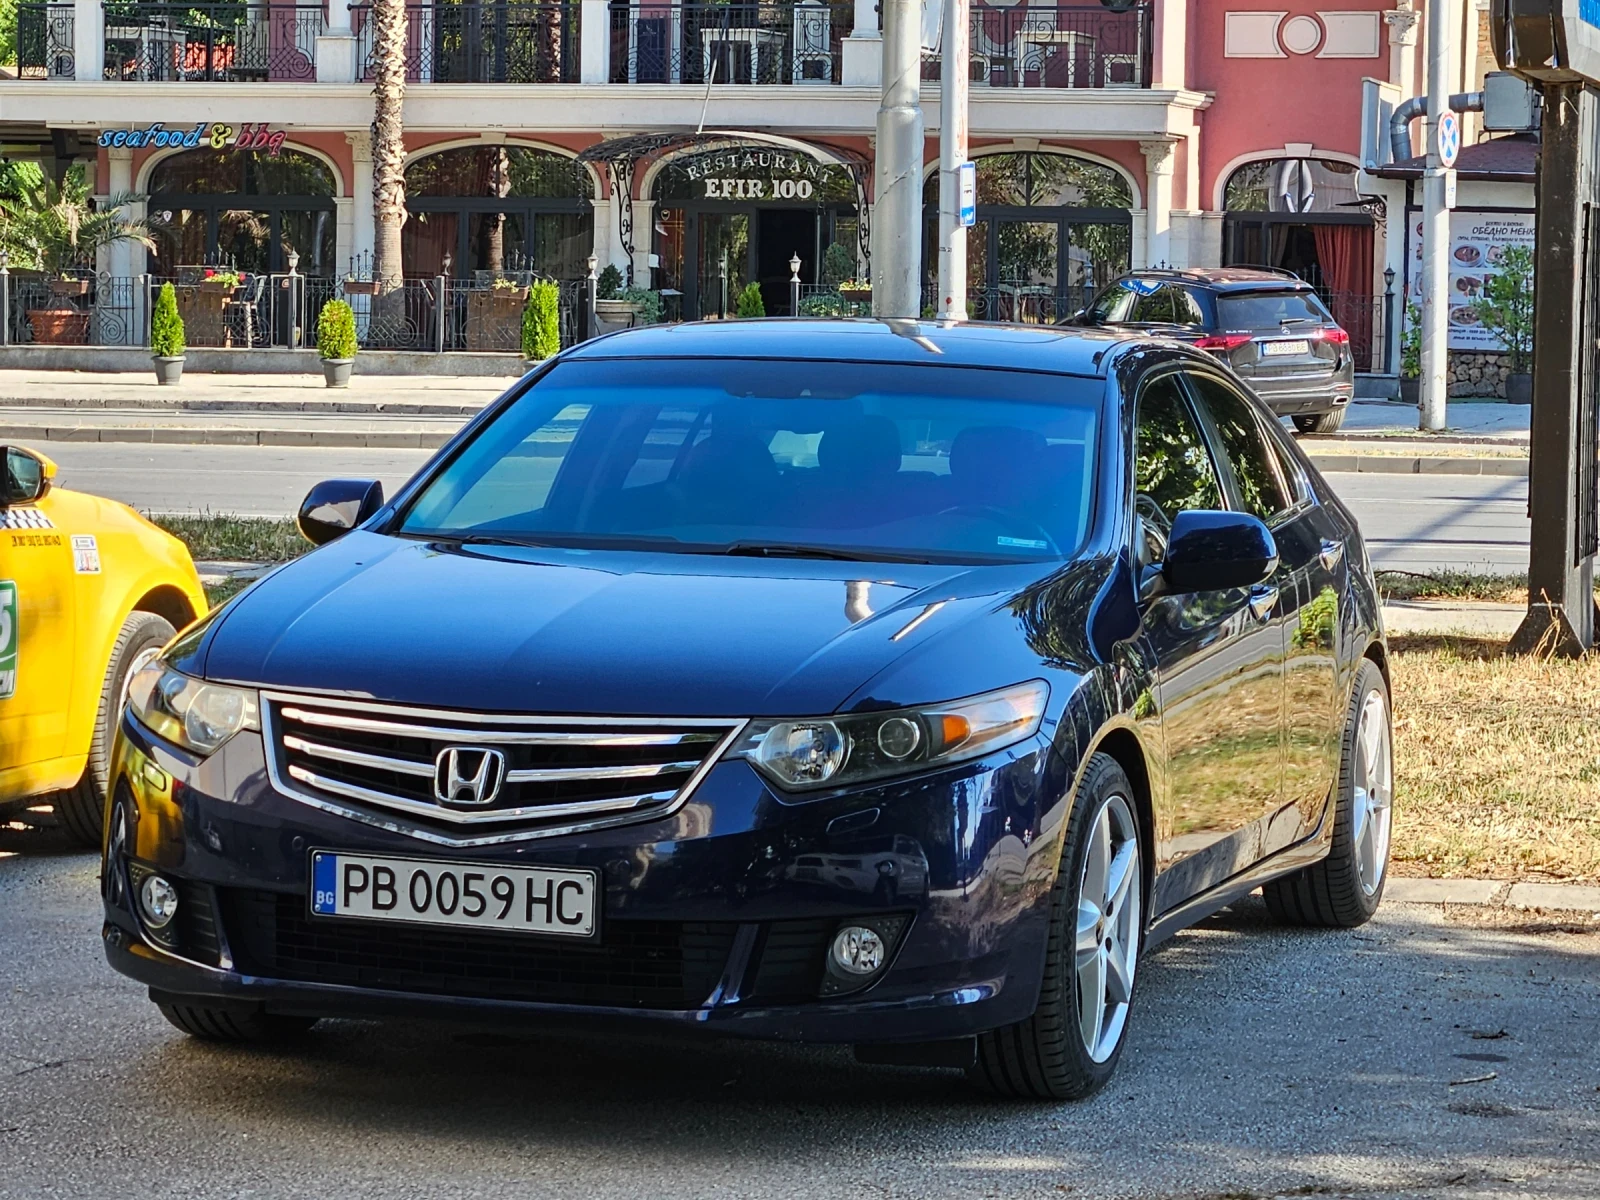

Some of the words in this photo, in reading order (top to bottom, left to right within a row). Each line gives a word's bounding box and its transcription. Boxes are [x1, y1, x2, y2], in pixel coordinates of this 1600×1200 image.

[98, 122, 208, 148] seafood
[209, 122, 232, 149] &
[233, 122, 287, 156] bbq
[685, 153, 834, 182] RESTAURANT
[704, 178, 764, 198] EFIR
[772, 179, 812, 198] 100
[1472, 226, 1508, 236] ОБЕДНО
[316, 891, 334, 905] BG
[343, 863, 398, 910] PB
[409, 868, 515, 920] 0059
[525, 877, 584, 925] HC
